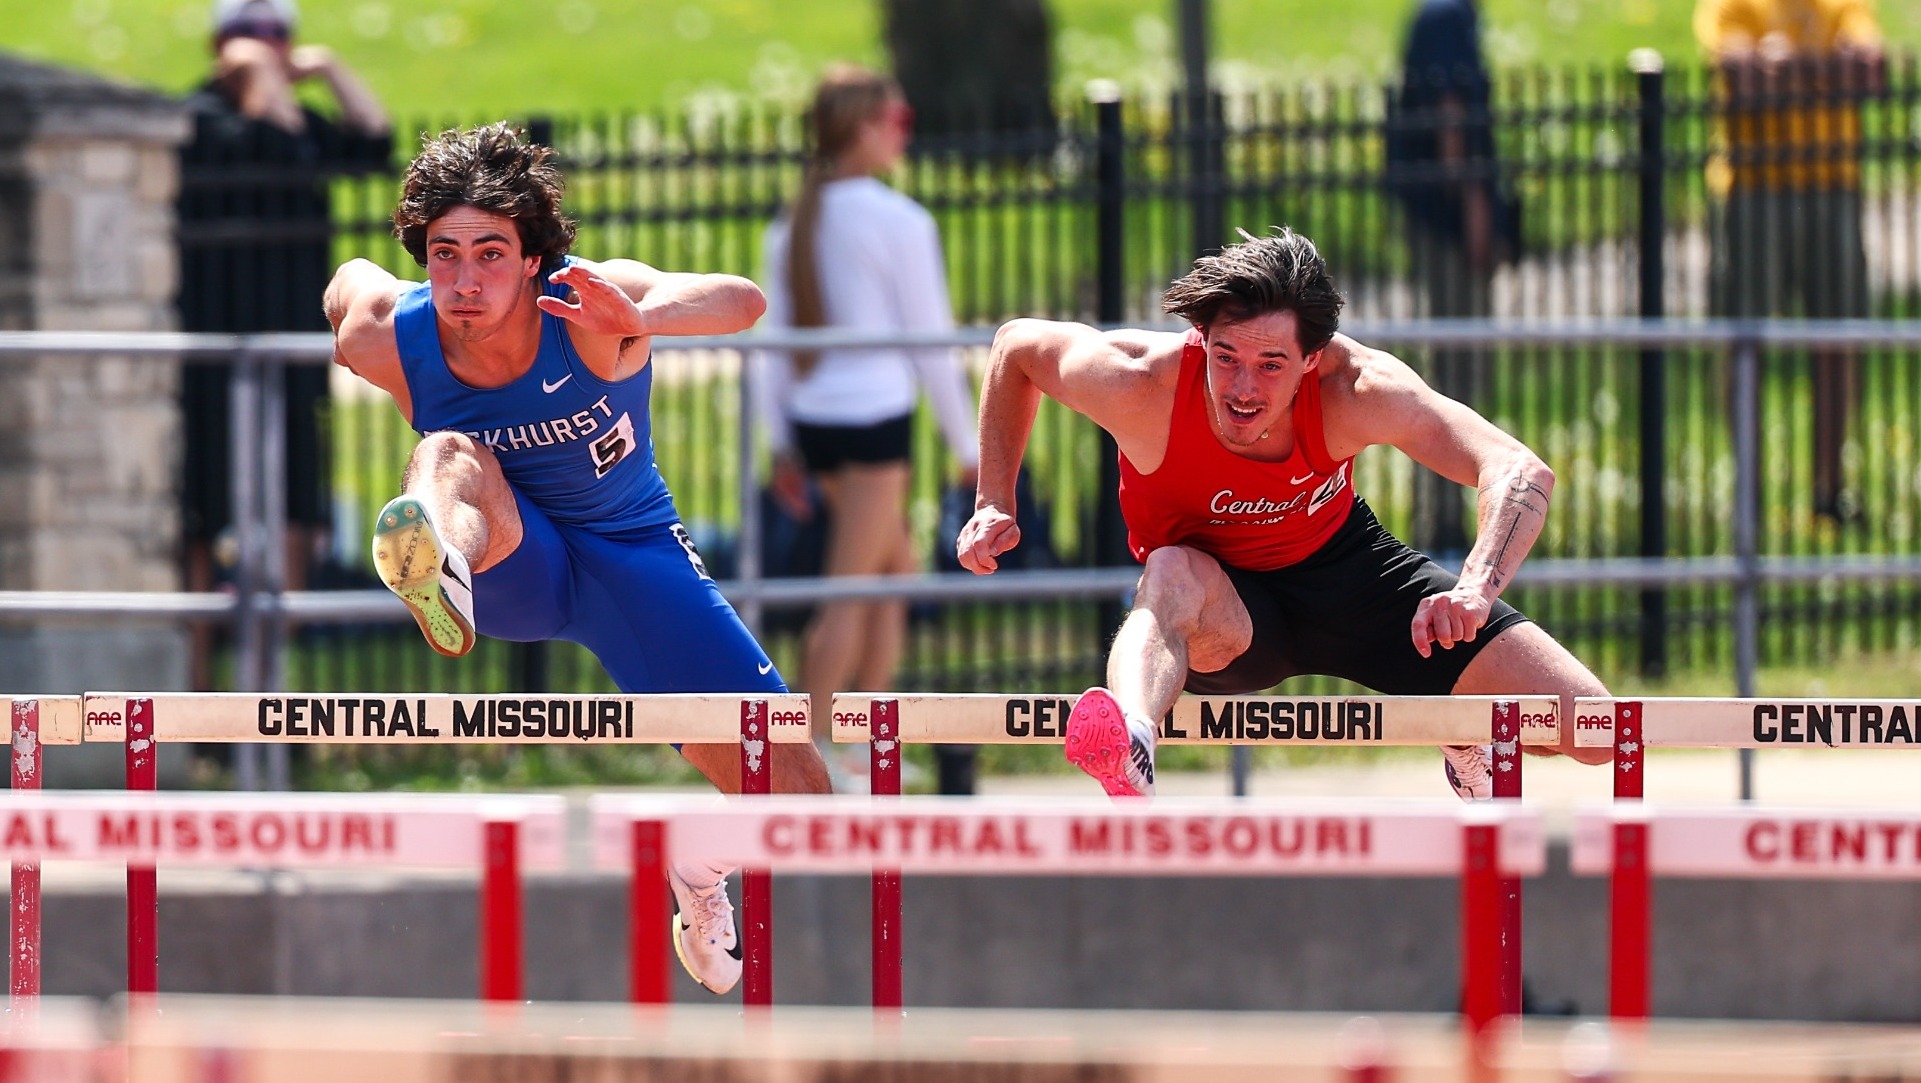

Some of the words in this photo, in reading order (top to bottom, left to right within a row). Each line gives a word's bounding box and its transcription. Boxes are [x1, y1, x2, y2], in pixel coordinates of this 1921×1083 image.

[423, 394, 613, 453] KHURST
[593, 421, 630, 477] 5
[1210, 489, 1307, 514] Central
[257, 698, 440, 738] CENTRAL
[452, 699, 634, 739] MISSOURI
[1199, 700, 1383, 741] MISSOURI
[1753, 703, 1921, 745] CENTRA
[97, 812, 396, 854] MISSOURI
[760, 815, 1042, 858] CENTRAL
[1068, 814, 1374, 858] MISSOURI
[1745, 819, 1921, 864] CENT
